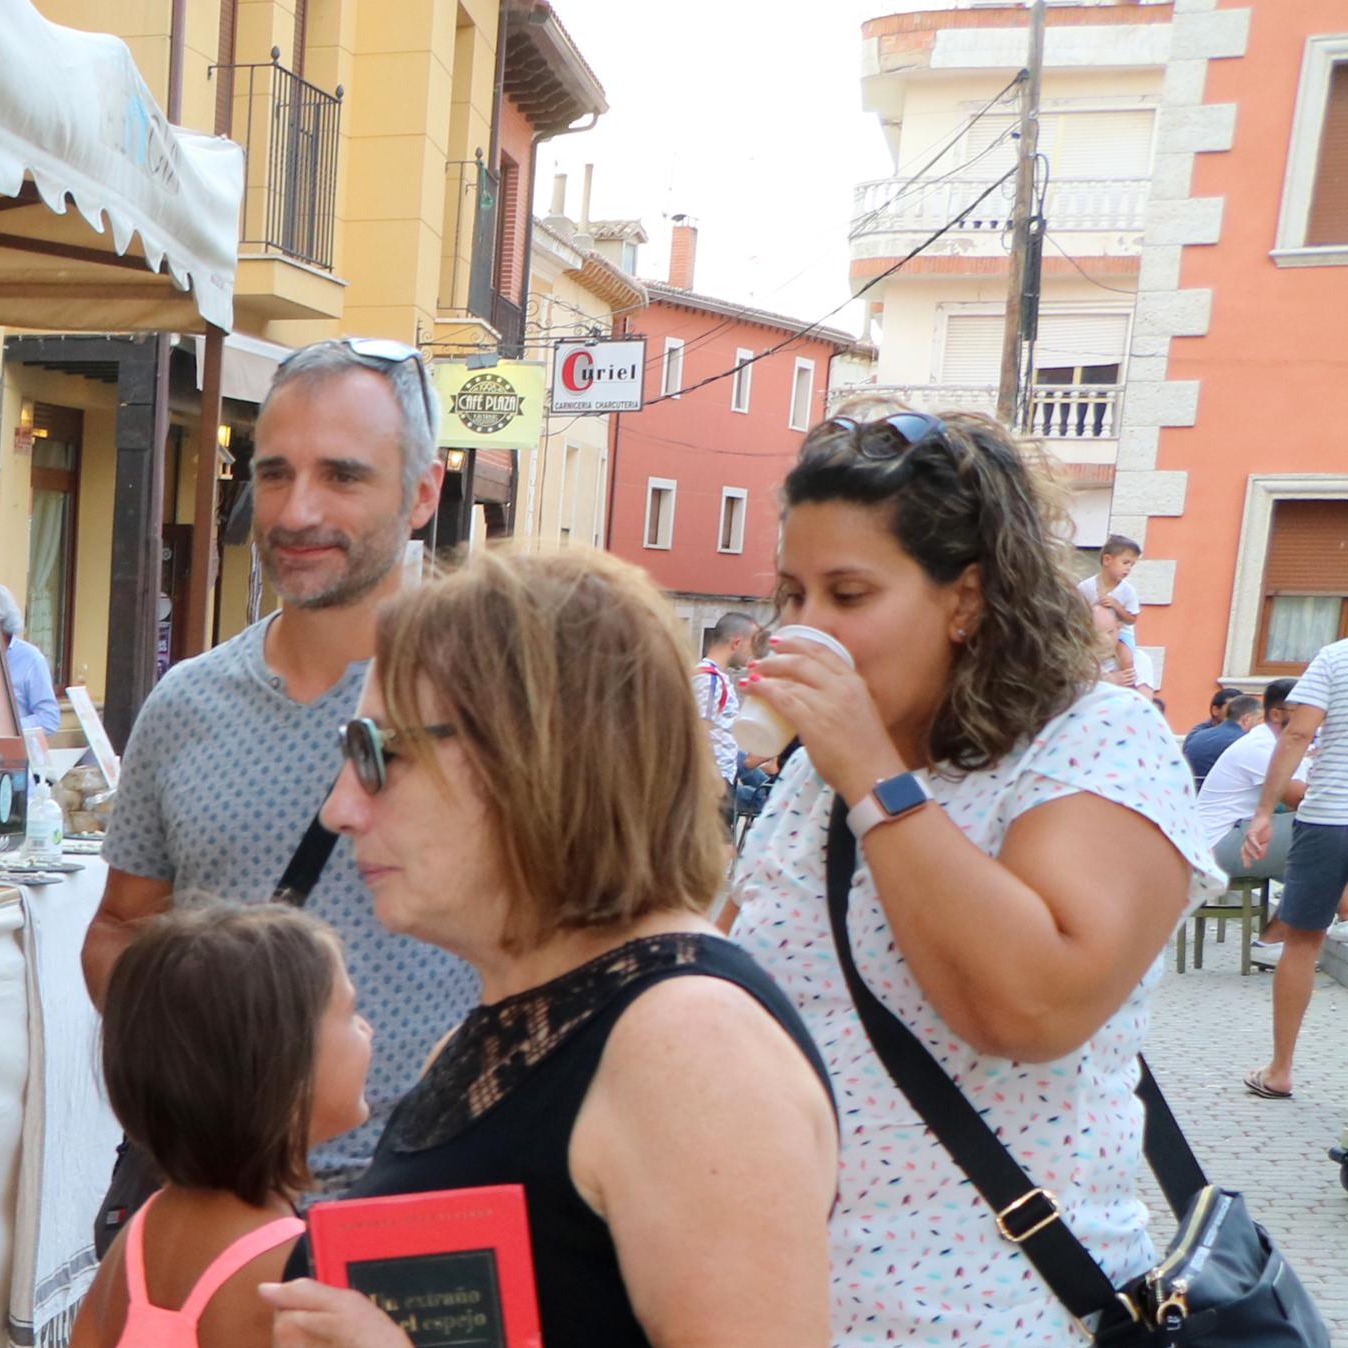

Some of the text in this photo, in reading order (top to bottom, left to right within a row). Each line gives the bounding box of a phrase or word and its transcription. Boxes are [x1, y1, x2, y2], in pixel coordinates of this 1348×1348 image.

[562, 351, 636, 392] Curiel
[485, 395, 516, 411] PLAZA
[422, 1309, 487, 1335] espejo
